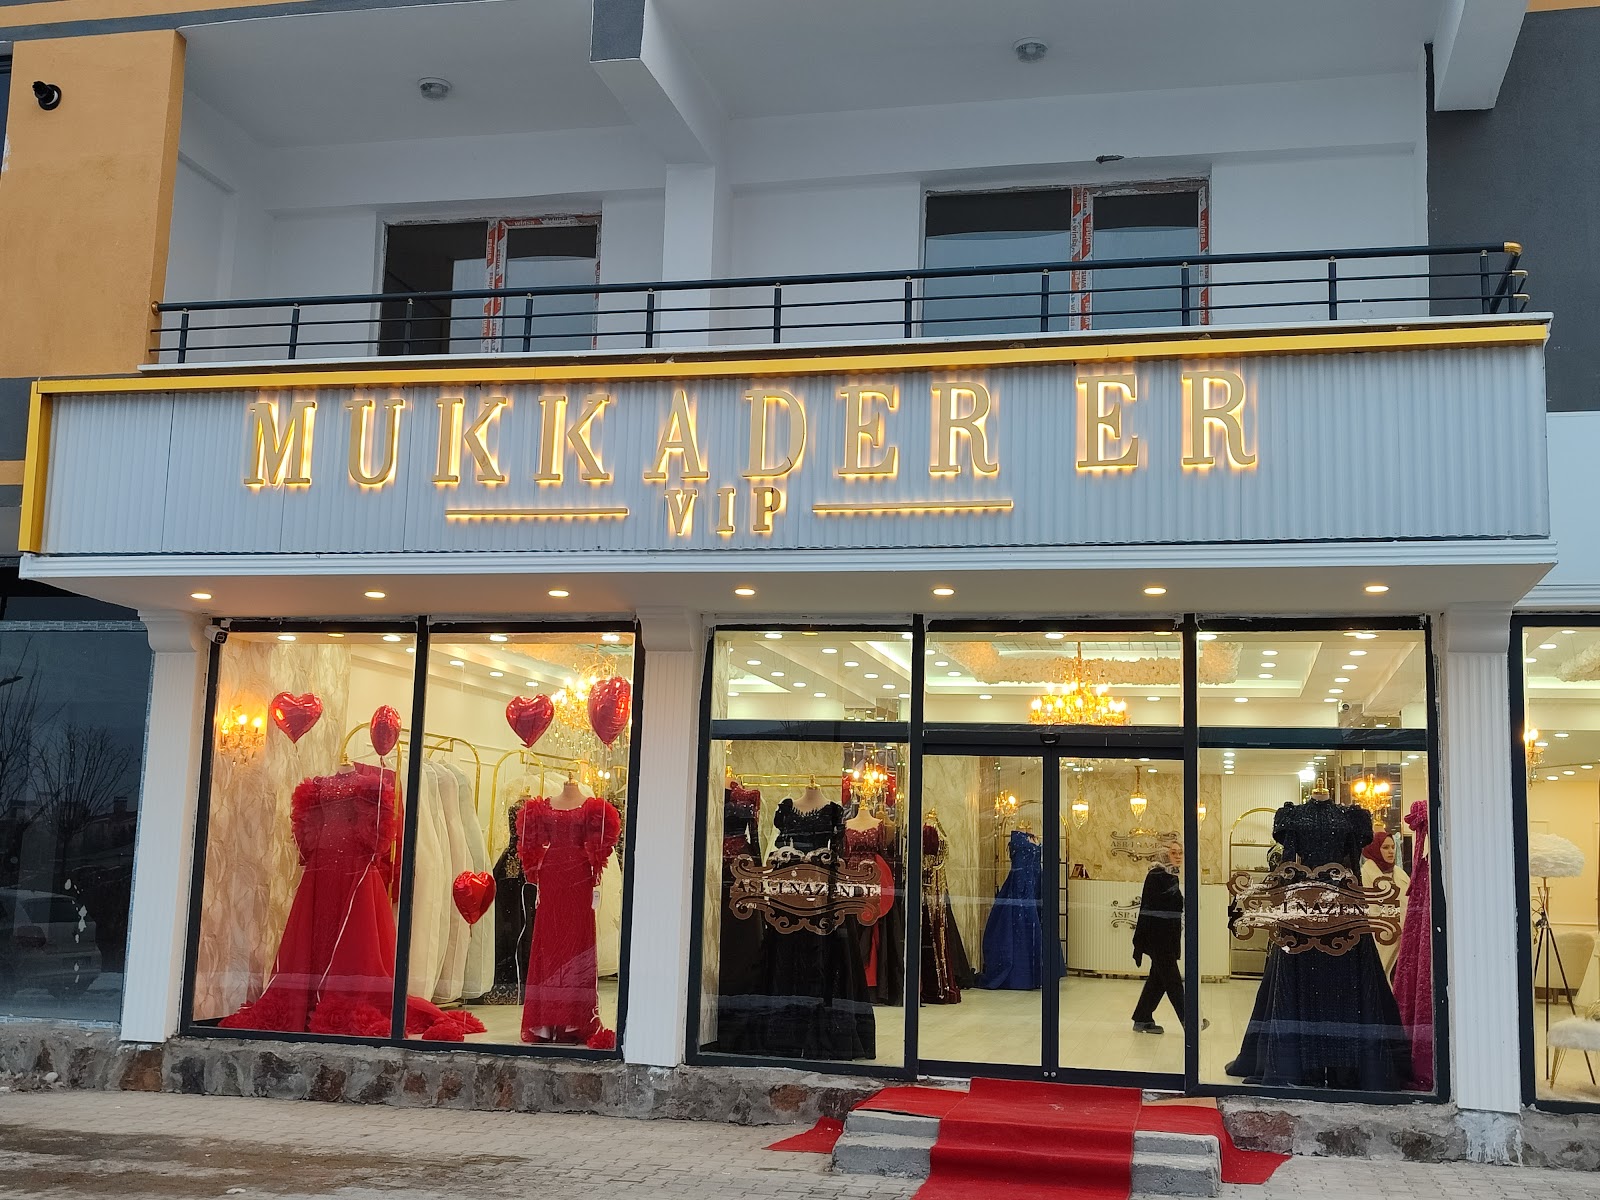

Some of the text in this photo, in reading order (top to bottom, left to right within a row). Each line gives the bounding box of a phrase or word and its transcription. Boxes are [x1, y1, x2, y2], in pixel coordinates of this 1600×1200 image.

[243, 369, 1257, 486] MUKKADER ER
[664, 485, 787, 536] VIP
